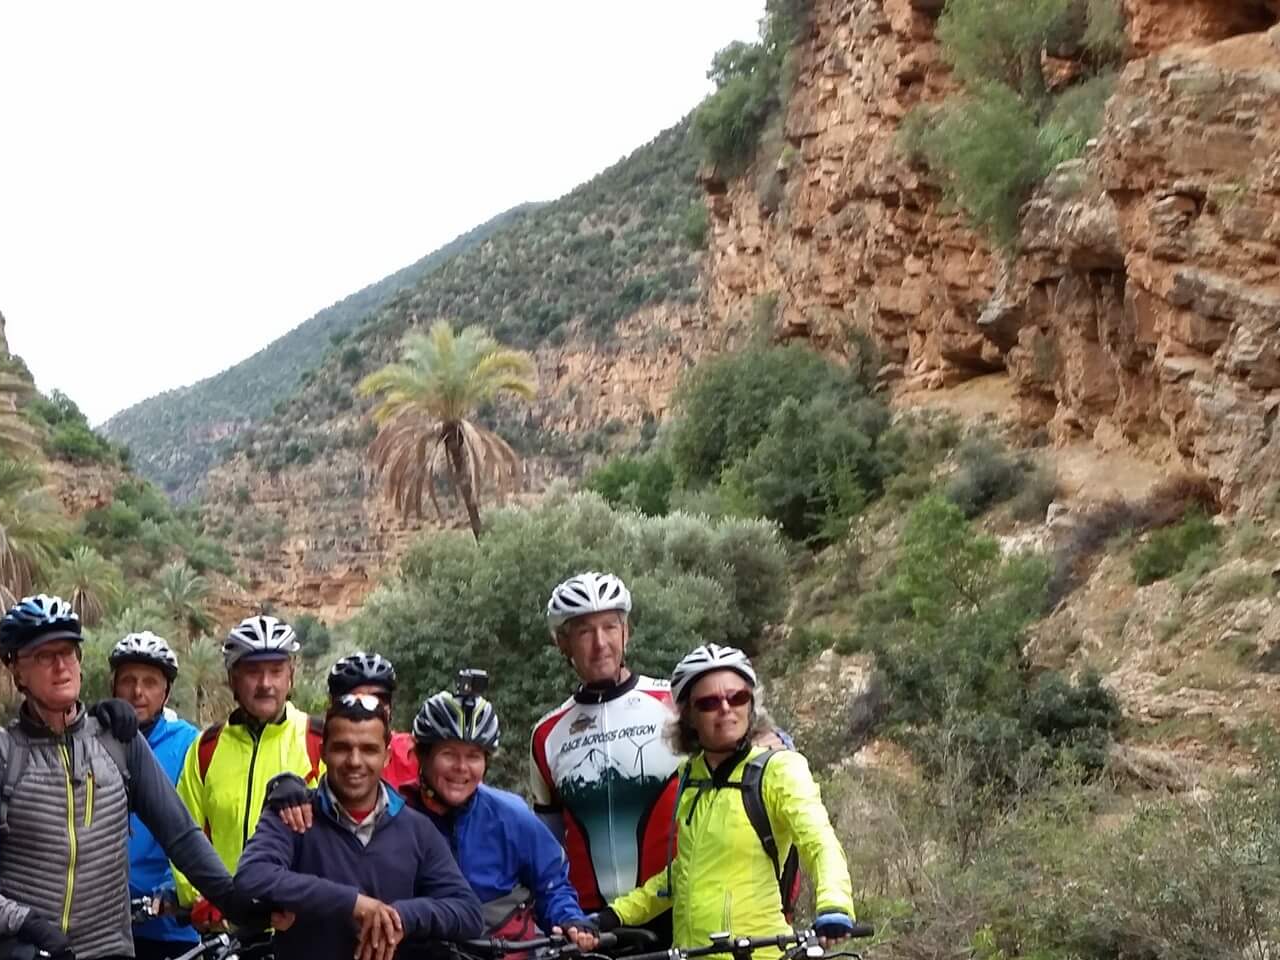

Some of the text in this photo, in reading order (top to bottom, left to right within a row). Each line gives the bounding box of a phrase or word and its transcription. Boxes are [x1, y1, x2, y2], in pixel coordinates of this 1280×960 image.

[561, 724, 657, 753] RACE ACROSS OREGON
